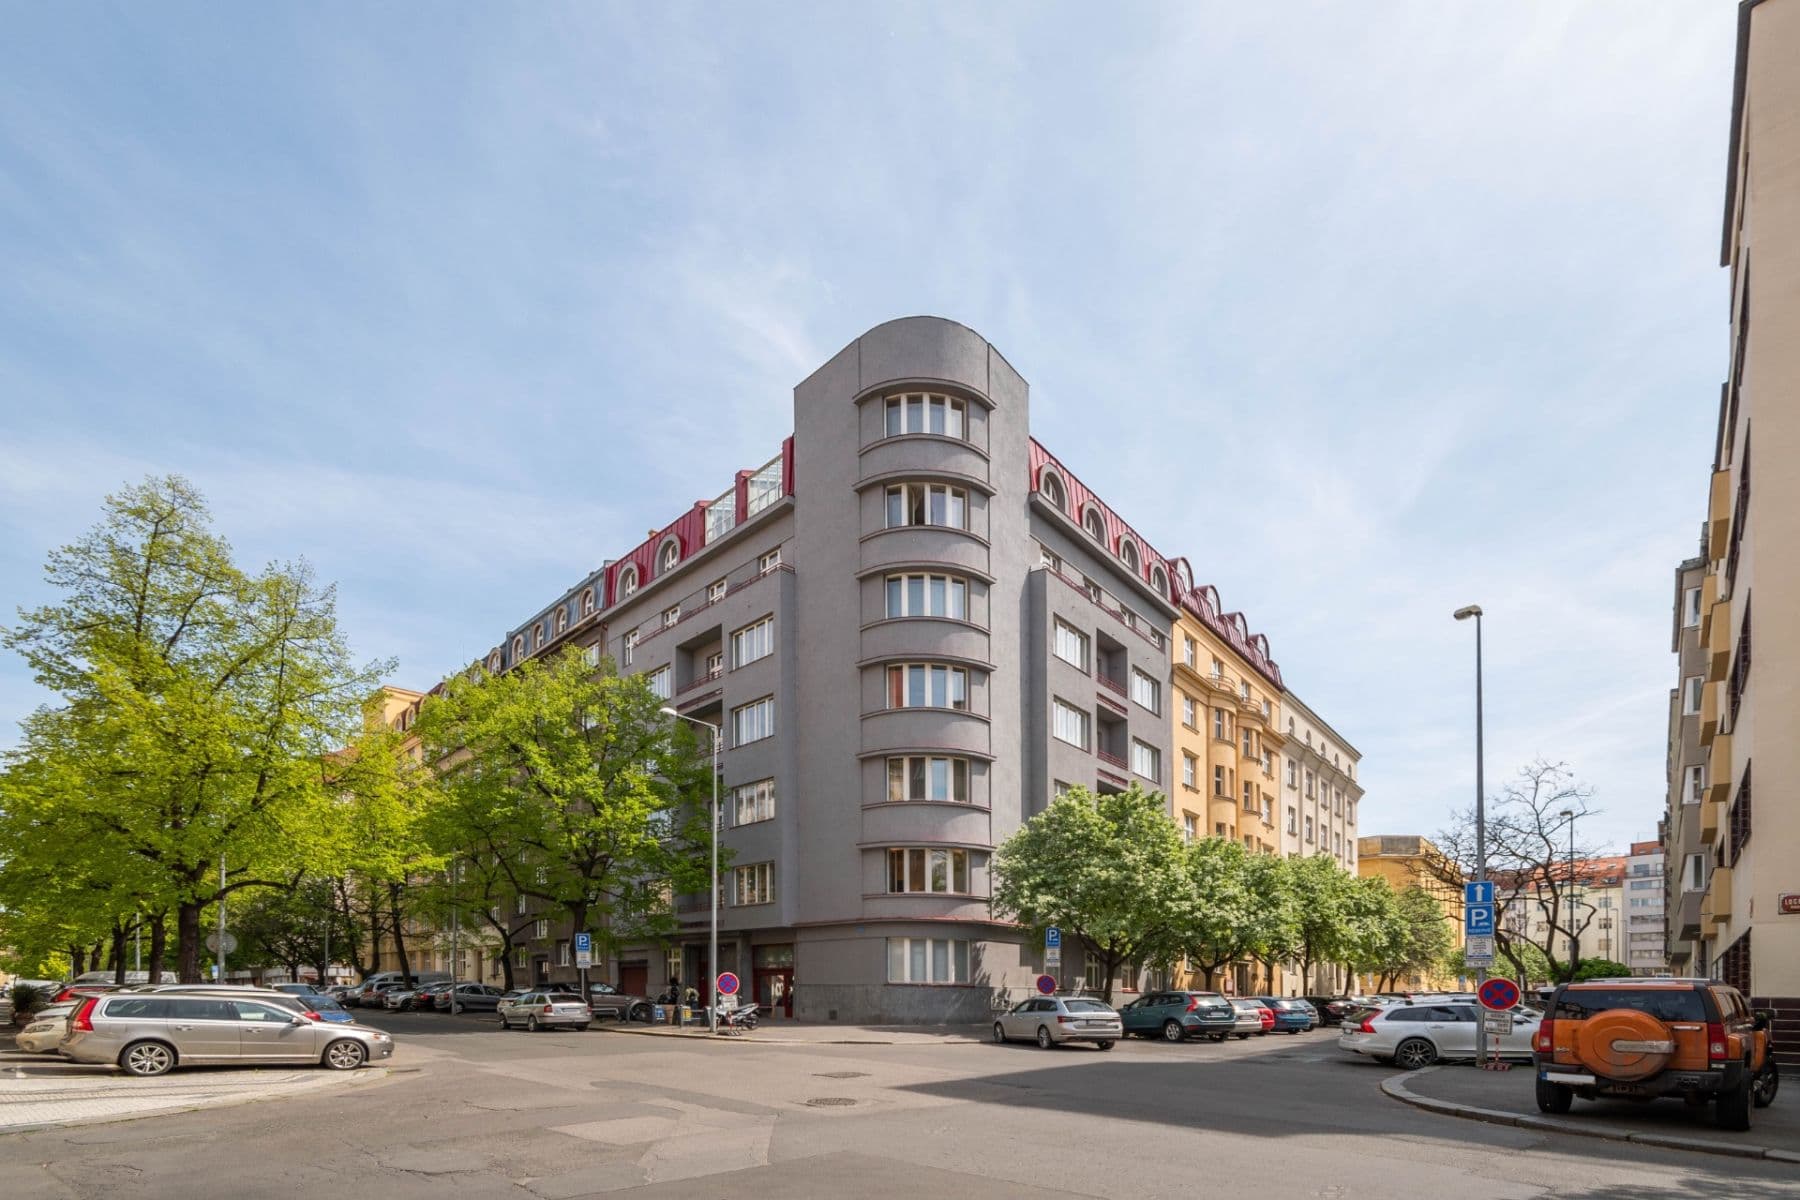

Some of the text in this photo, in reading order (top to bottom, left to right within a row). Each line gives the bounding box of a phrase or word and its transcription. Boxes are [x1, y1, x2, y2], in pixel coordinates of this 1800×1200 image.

[1471, 908, 1488, 927] P
[579, 935, 588, 946] P
[1049, 929, 1058, 941] P
